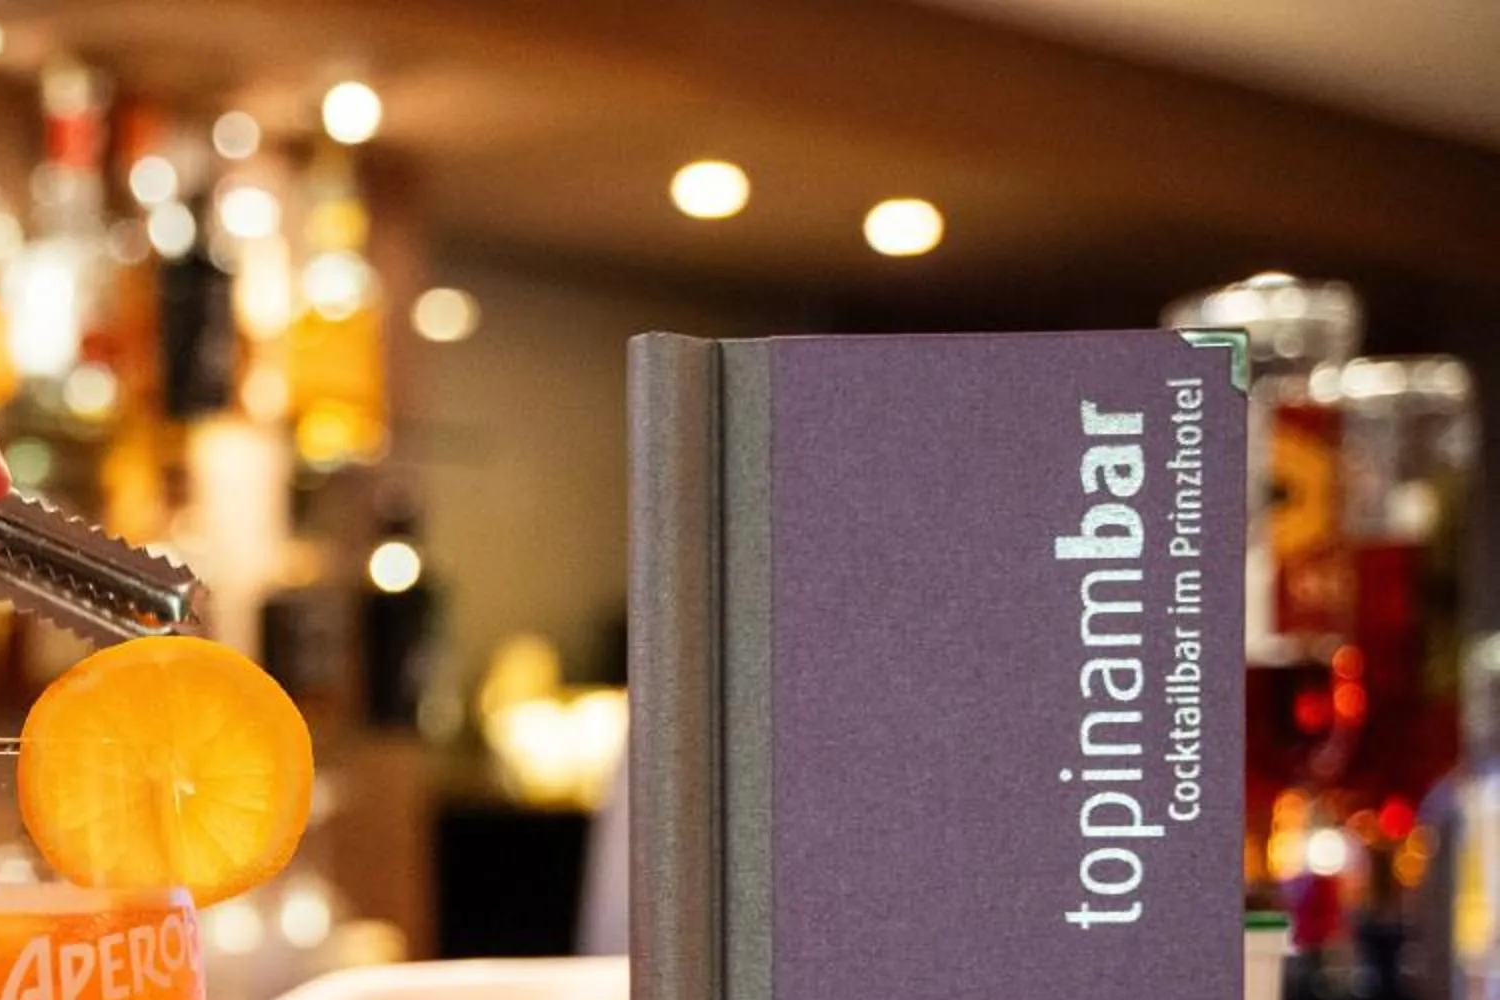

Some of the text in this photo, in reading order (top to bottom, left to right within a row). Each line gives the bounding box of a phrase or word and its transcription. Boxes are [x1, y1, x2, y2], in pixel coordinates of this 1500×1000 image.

[1055, 399, 1165, 929] topinambar
[1165, 377, 1203, 822] Cocktailbar im Prinzhotel
